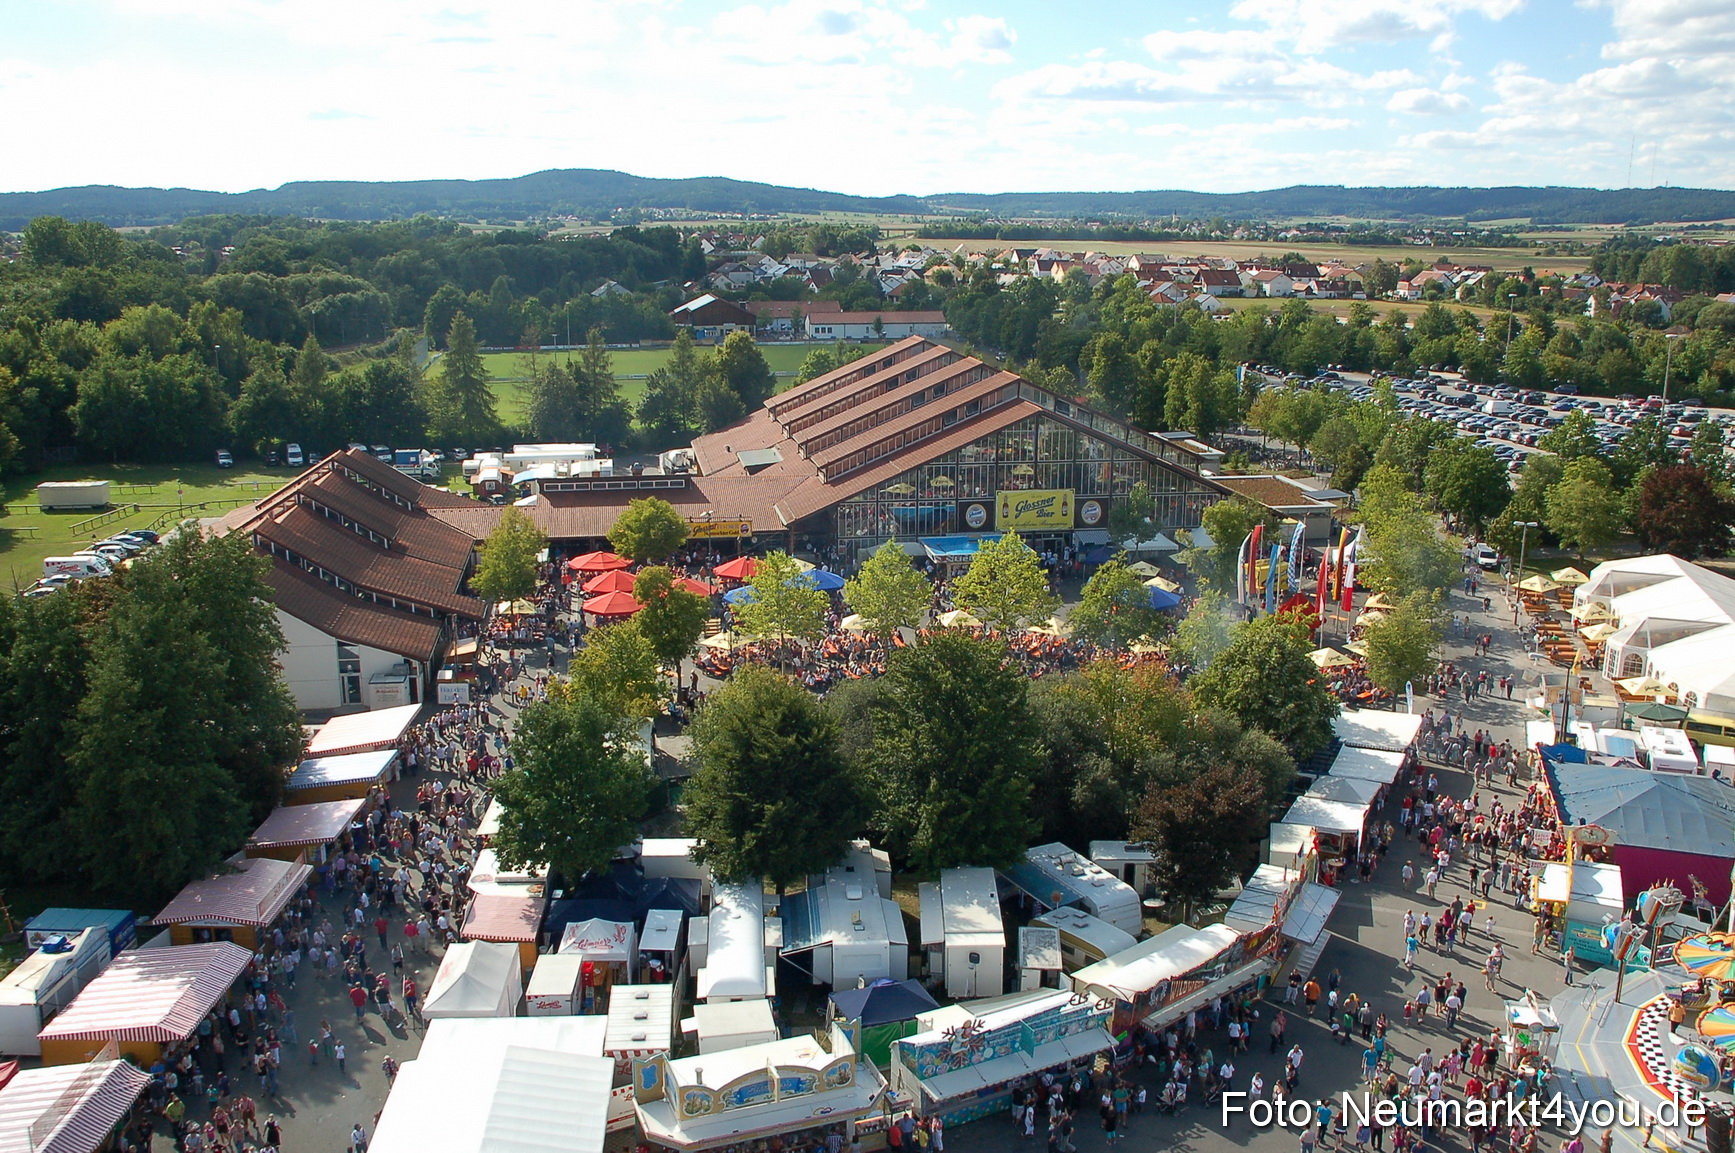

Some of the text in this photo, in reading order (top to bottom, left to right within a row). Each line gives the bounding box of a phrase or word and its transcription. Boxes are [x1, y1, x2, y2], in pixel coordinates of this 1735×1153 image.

[1015, 496, 1056, 519] Glossner
[1036, 508, 1055, 518] Bier
[1069, 992, 1090, 1006] EIS
[1094, 997, 1115, 1010] EIS
